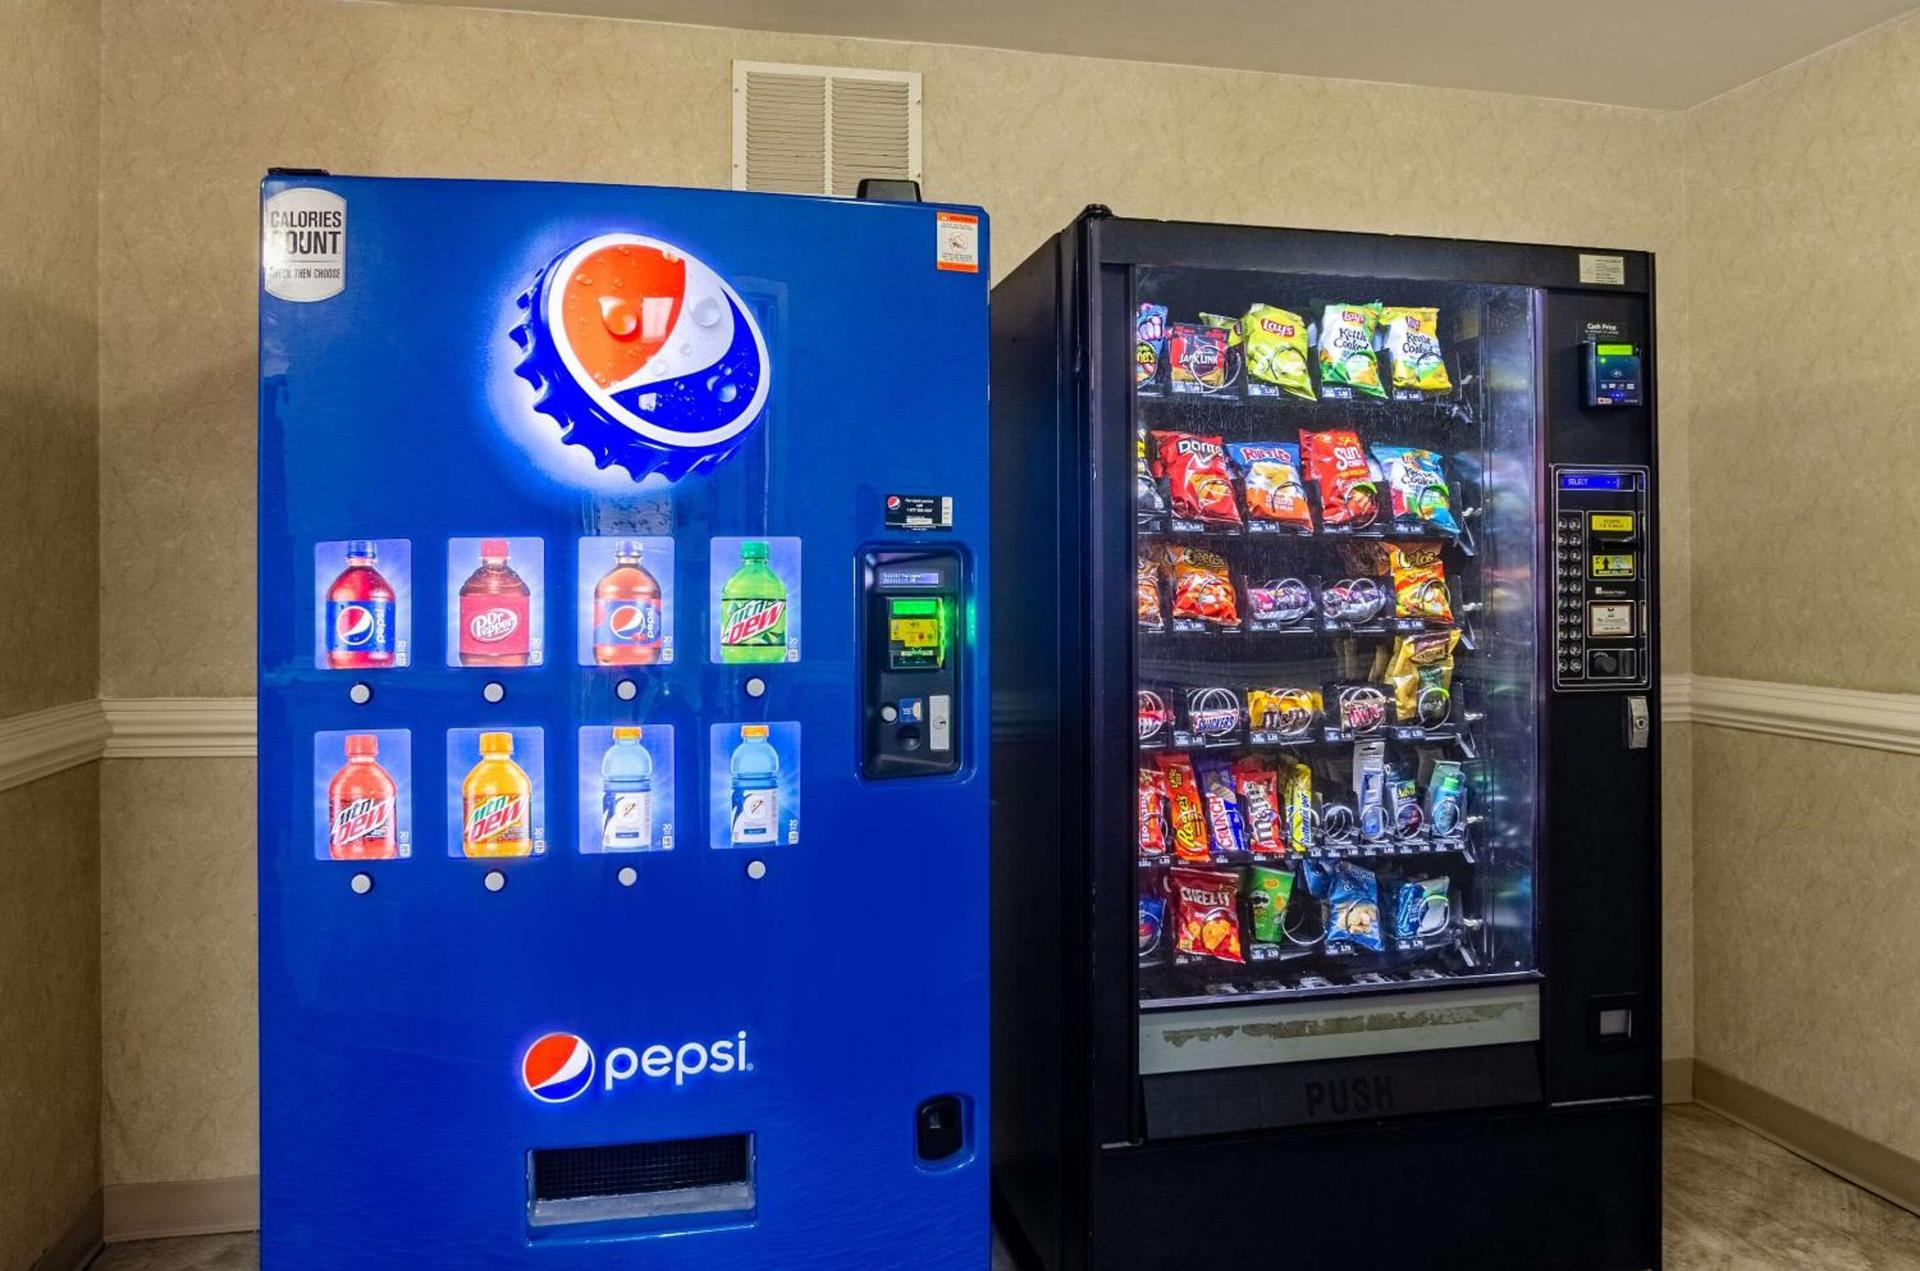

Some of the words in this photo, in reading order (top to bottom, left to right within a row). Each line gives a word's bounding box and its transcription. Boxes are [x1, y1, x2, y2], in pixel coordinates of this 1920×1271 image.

[271, 211, 342, 228] CALORIES
[272, 231, 342, 255] OUNT
[295, 268, 312, 279] THEN
[314, 268, 341, 279] CHOOSE
[375, 608, 386, 644] pepsi
[475, 614, 517, 638] Pepper
[488, 611, 504, 624] Dr
[646, 607, 655, 638] pepsi
[1209, 794, 1234, 849] CRUNCH
[605, 1030, 747, 1091] pepsi
[1305, 1074, 1394, 1117] PUSH
